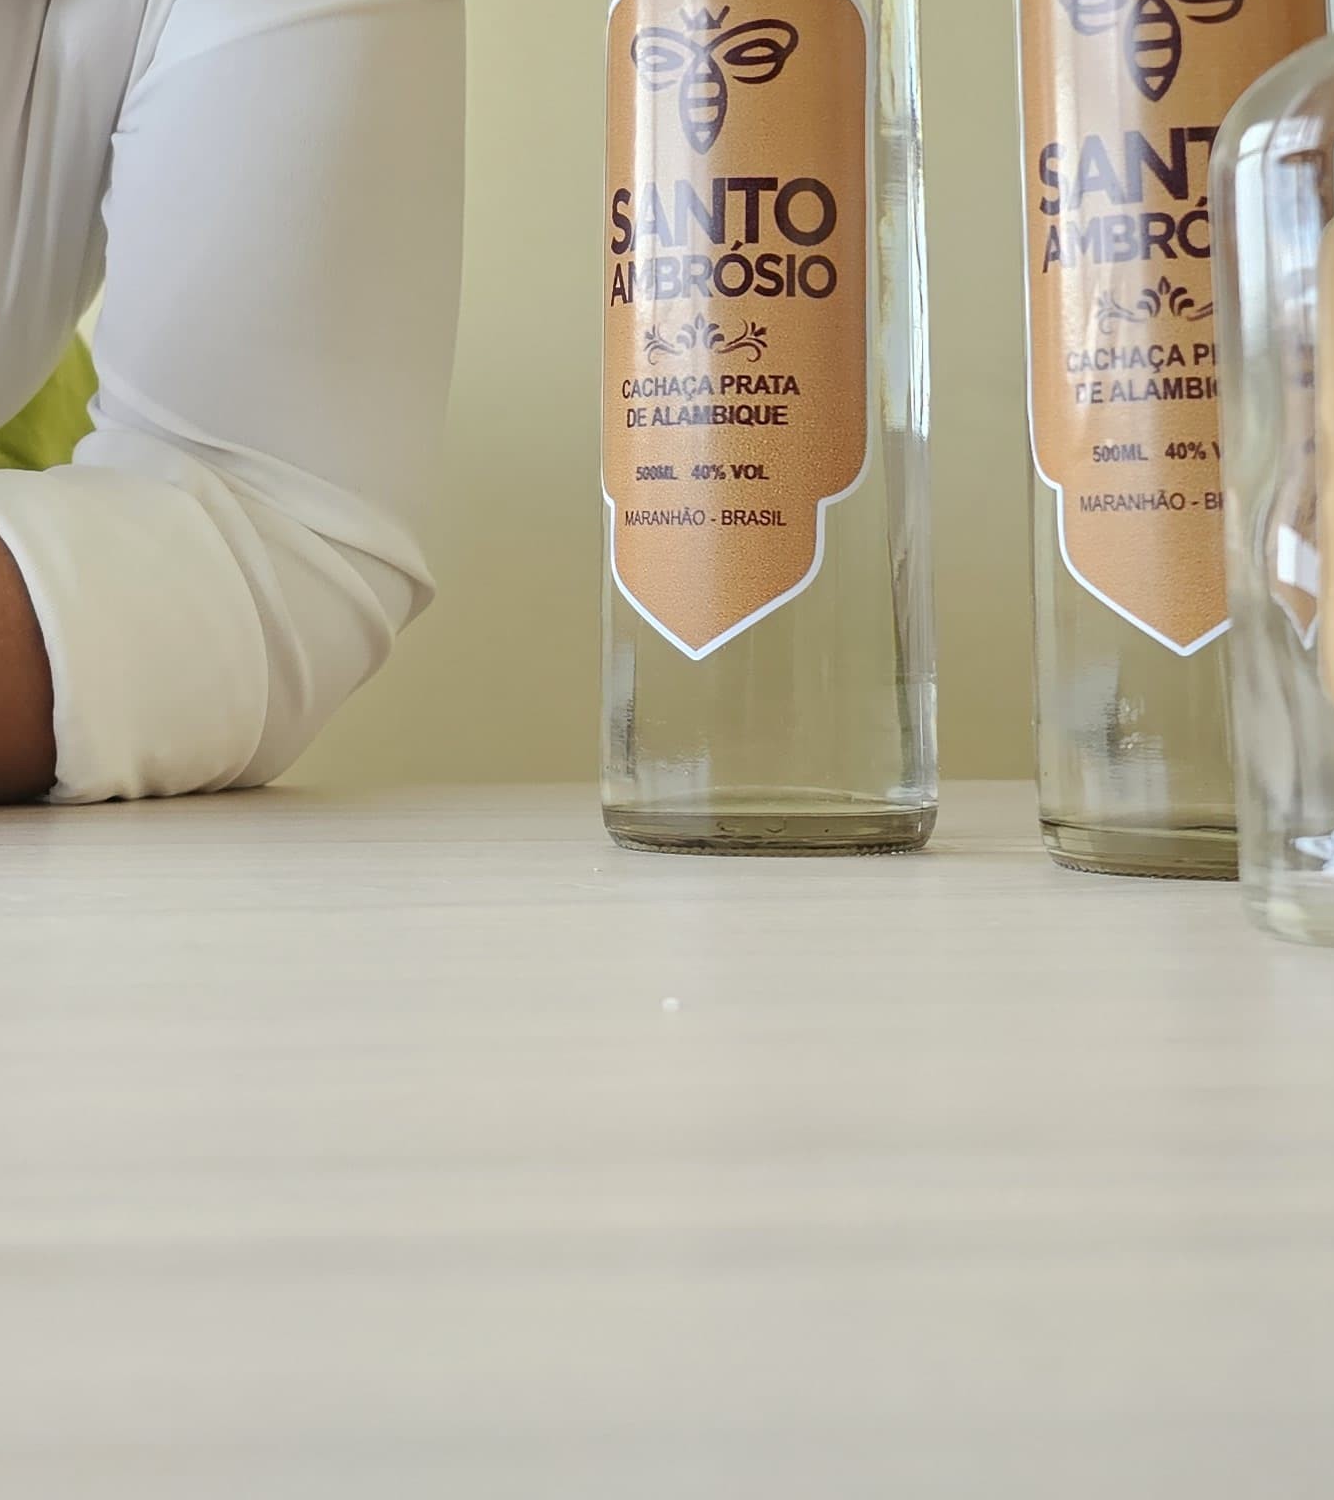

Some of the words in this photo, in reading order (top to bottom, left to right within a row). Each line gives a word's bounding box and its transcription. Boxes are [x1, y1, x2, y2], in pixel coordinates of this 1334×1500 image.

[1039, 126, 1221, 216] SANT
[610, 177, 837, 255] SANTO
[1042, 196, 1211, 273] AMBRÓ
[610, 240, 837, 306] AMBRÓSIO
[1066, 343, 1186, 372] CACHAÇA
[622, 375, 715, 400] CACHAÇA
[720, 375, 800, 396] PRATA
[1075, 381, 1103, 404] DE
[1110, 376, 1218, 402] ALAMBI
[627, 407, 647, 428] DE
[651, 404, 788, 426] ALAMBIQUE
[1092, 443, 1148, 463] 500ML
[1164, 441, 1207, 460] 40%
[636, 464, 678, 481] 500ML
[691, 464, 726, 480] 40%
[730, 464, 769, 480] VOL
[1080, 490, 1185, 512] MARANHÃO
[625, 507, 706, 527] MARANHÃO
[721, 509, 786, 526] BRASIL
